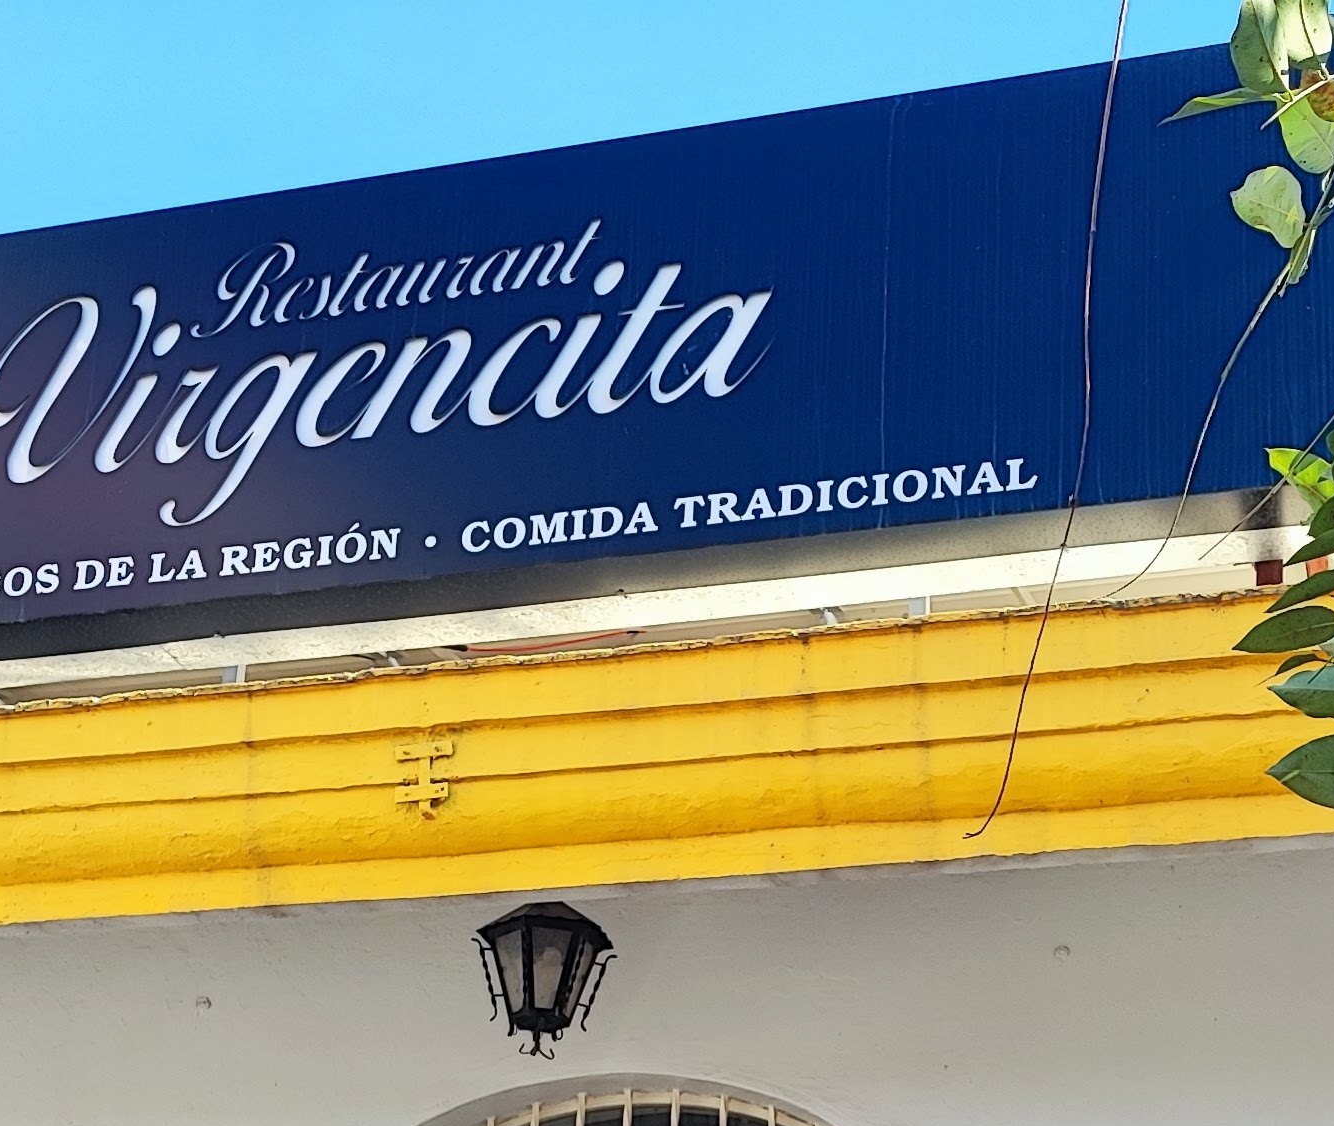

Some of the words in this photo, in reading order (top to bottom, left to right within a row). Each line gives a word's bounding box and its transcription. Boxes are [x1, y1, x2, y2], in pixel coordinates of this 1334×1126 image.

[189, 218, 602, 338] Restaurant
[74, 556, 135, 591] DE
[148, 548, 207, 584] LA
[219, 522, 401, 577] REGIÓN
[461, 502, 659, 553] COMIDA
[673, 458, 1039, 528] TRADICIONAL
